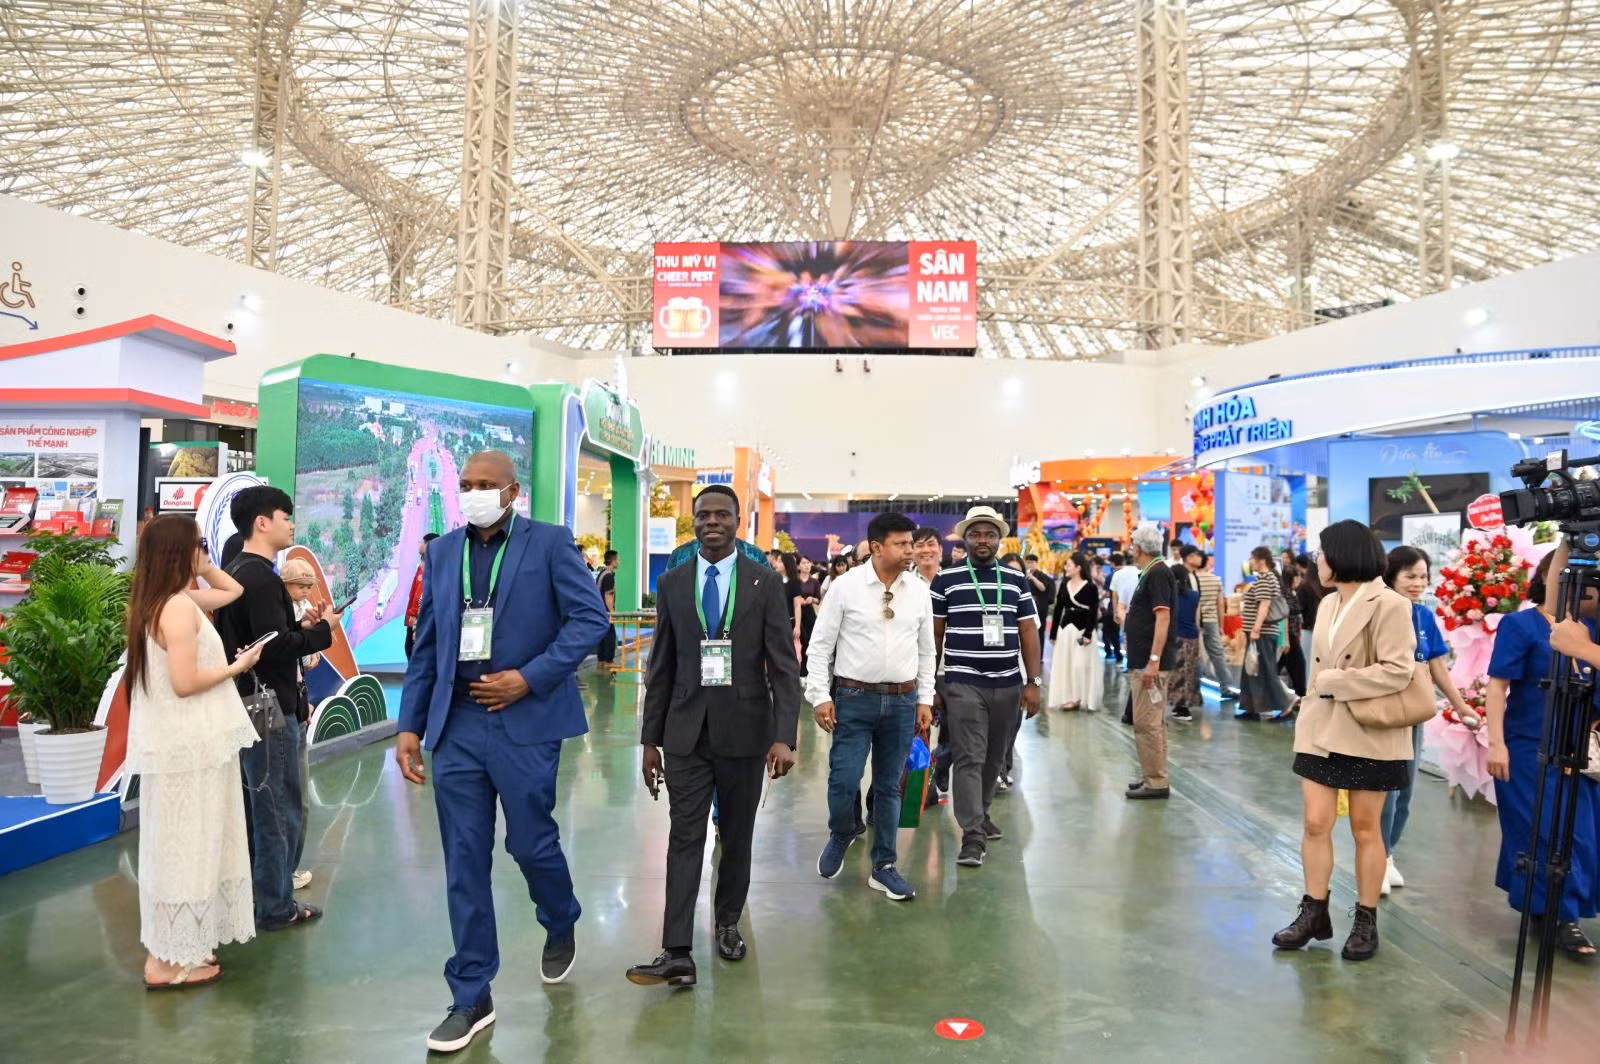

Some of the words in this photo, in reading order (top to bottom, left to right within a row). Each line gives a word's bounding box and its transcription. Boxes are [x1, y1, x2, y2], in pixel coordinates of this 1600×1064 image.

[655, 255, 680, 268] THU
[919, 248, 965, 275] SÂN
[916, 280, 969, 303] NAM
[930, 325, 961, 341] VEC
[1210, 424, 1243, 448] PHÁT
